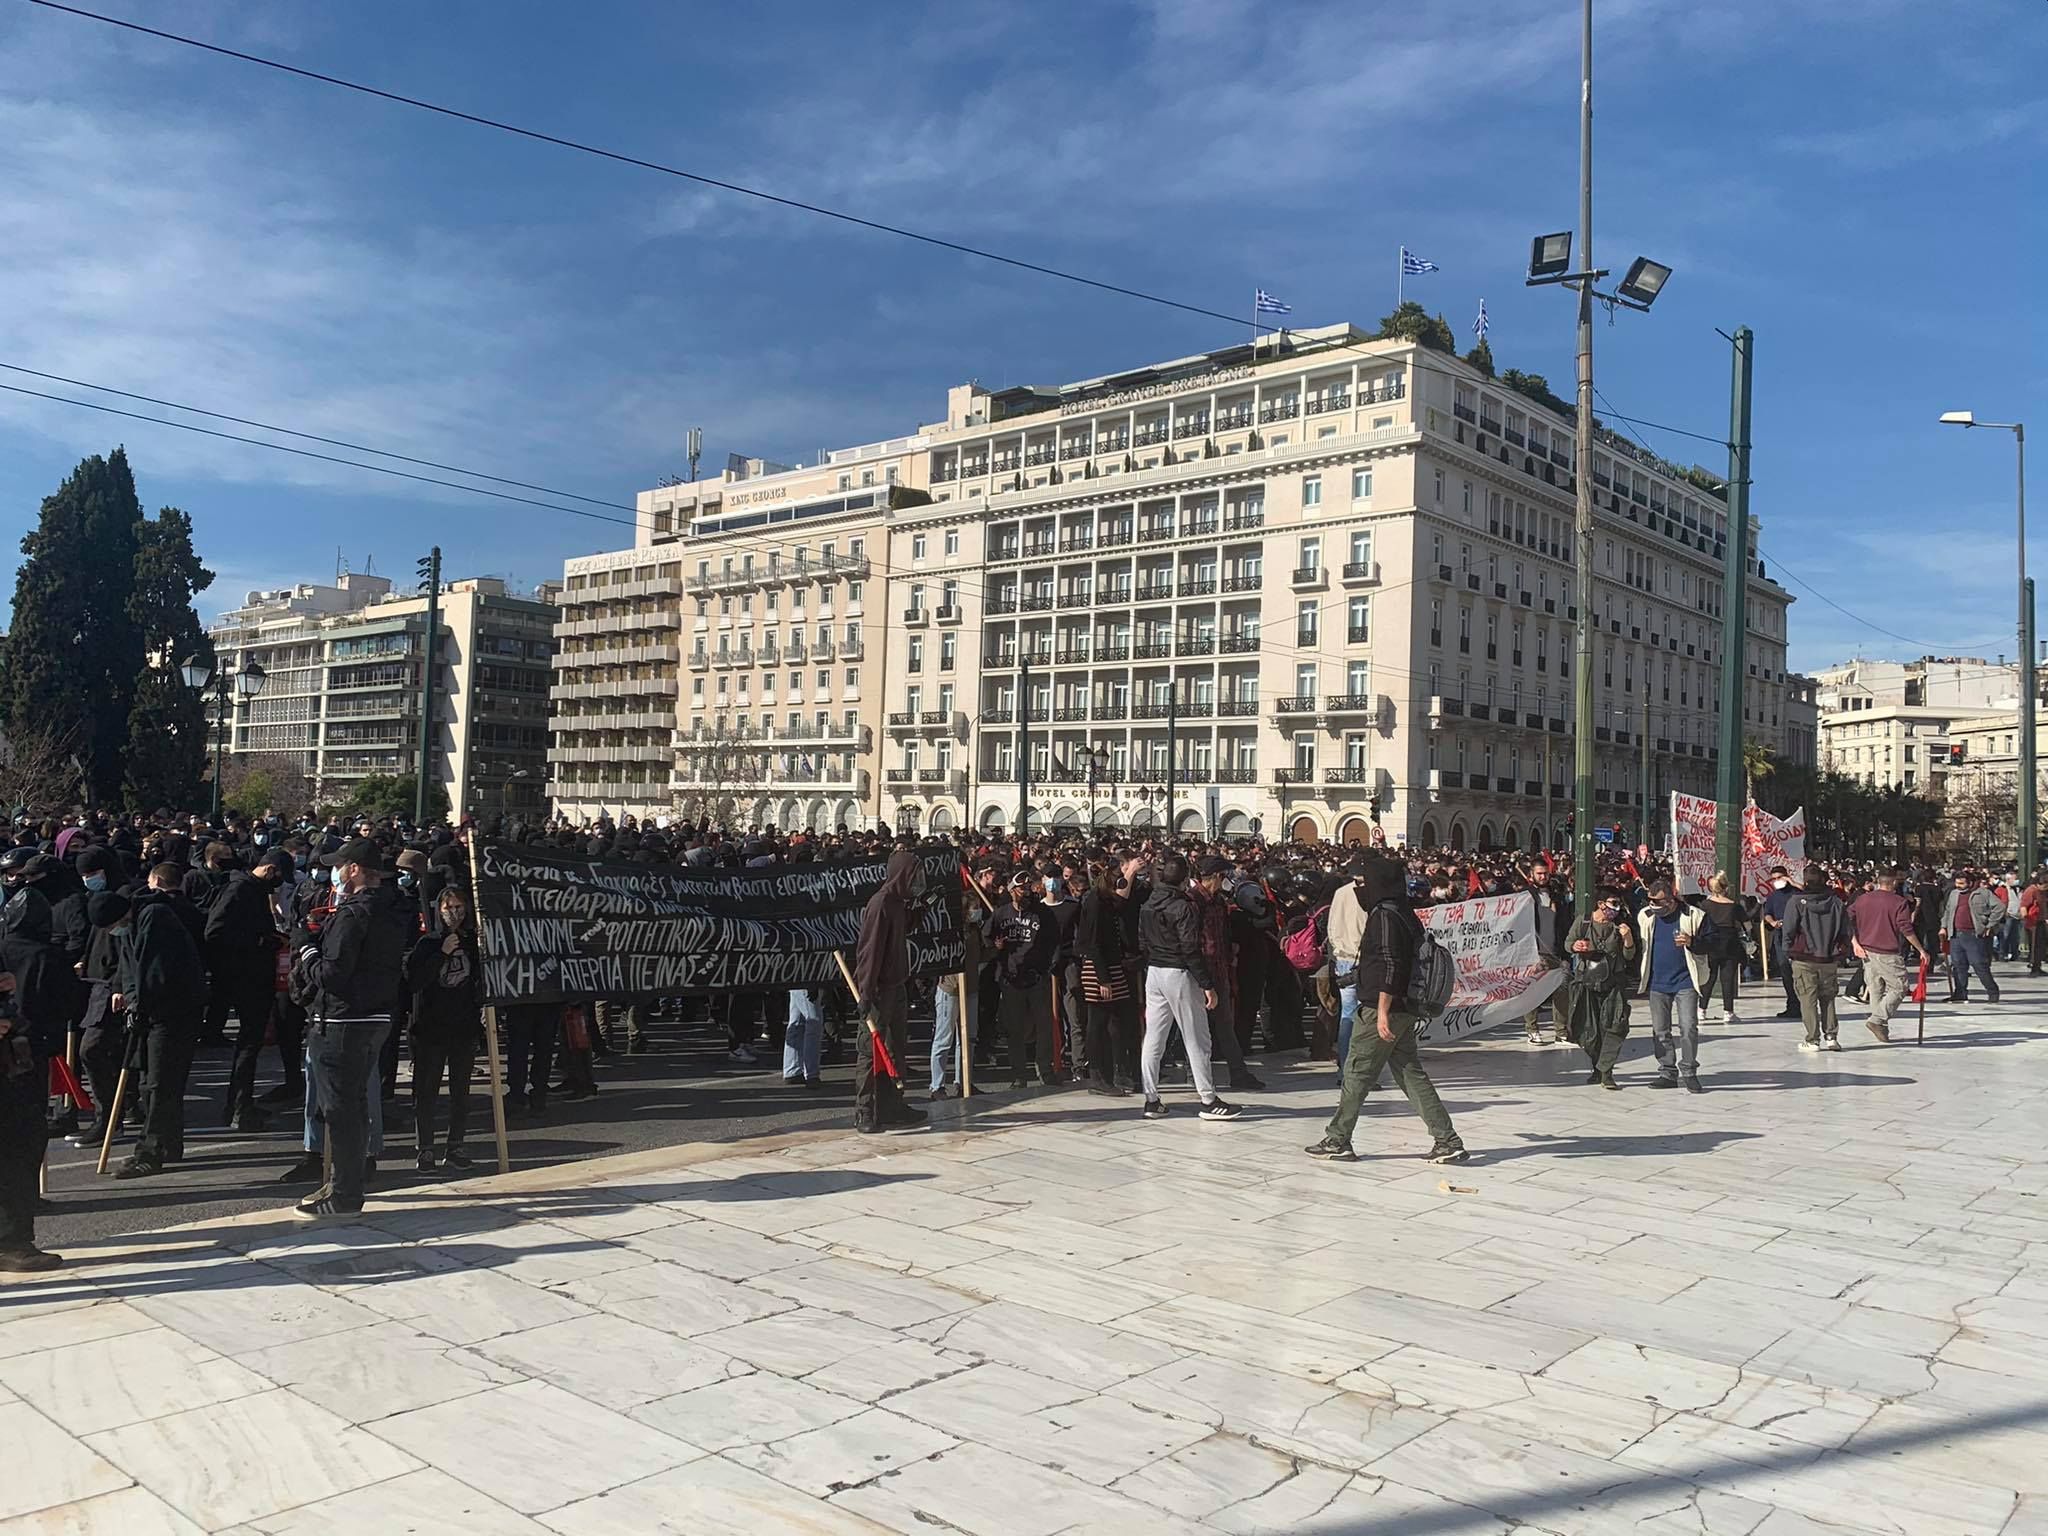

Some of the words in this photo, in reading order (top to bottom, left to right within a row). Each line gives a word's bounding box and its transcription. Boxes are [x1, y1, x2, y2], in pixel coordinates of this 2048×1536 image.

[1060, 397, 1102, 416] HOTEL
[1106, 382, 1164, 407] GRANDE
[1171, 365, 1249, 392] BRETAGNE
[592, 551, 638, 570] ATHENS
[639, 546, 680, 563] PLAZA
[1030, 788, 1066, 798] HOTEL
[1474, 902, 1486, 920] ΤΟ
[484, 918, 509, 956] ΝΑ
[510, 917, 584, 954] ΚΑΝΟΥΜΕ
[605, 916, 717, 953] ΦΟΙΤΗΤΙΚΟΥΣ
[484, 957, 535, 998] ΝΙΚΗ
[560, 953, 624, 992] ΑΠΕΡΓΙΑ
[629, 954, 702, 992] ΠΕΙΝΑΣ
[709, 954, 731, 987] Δ.
